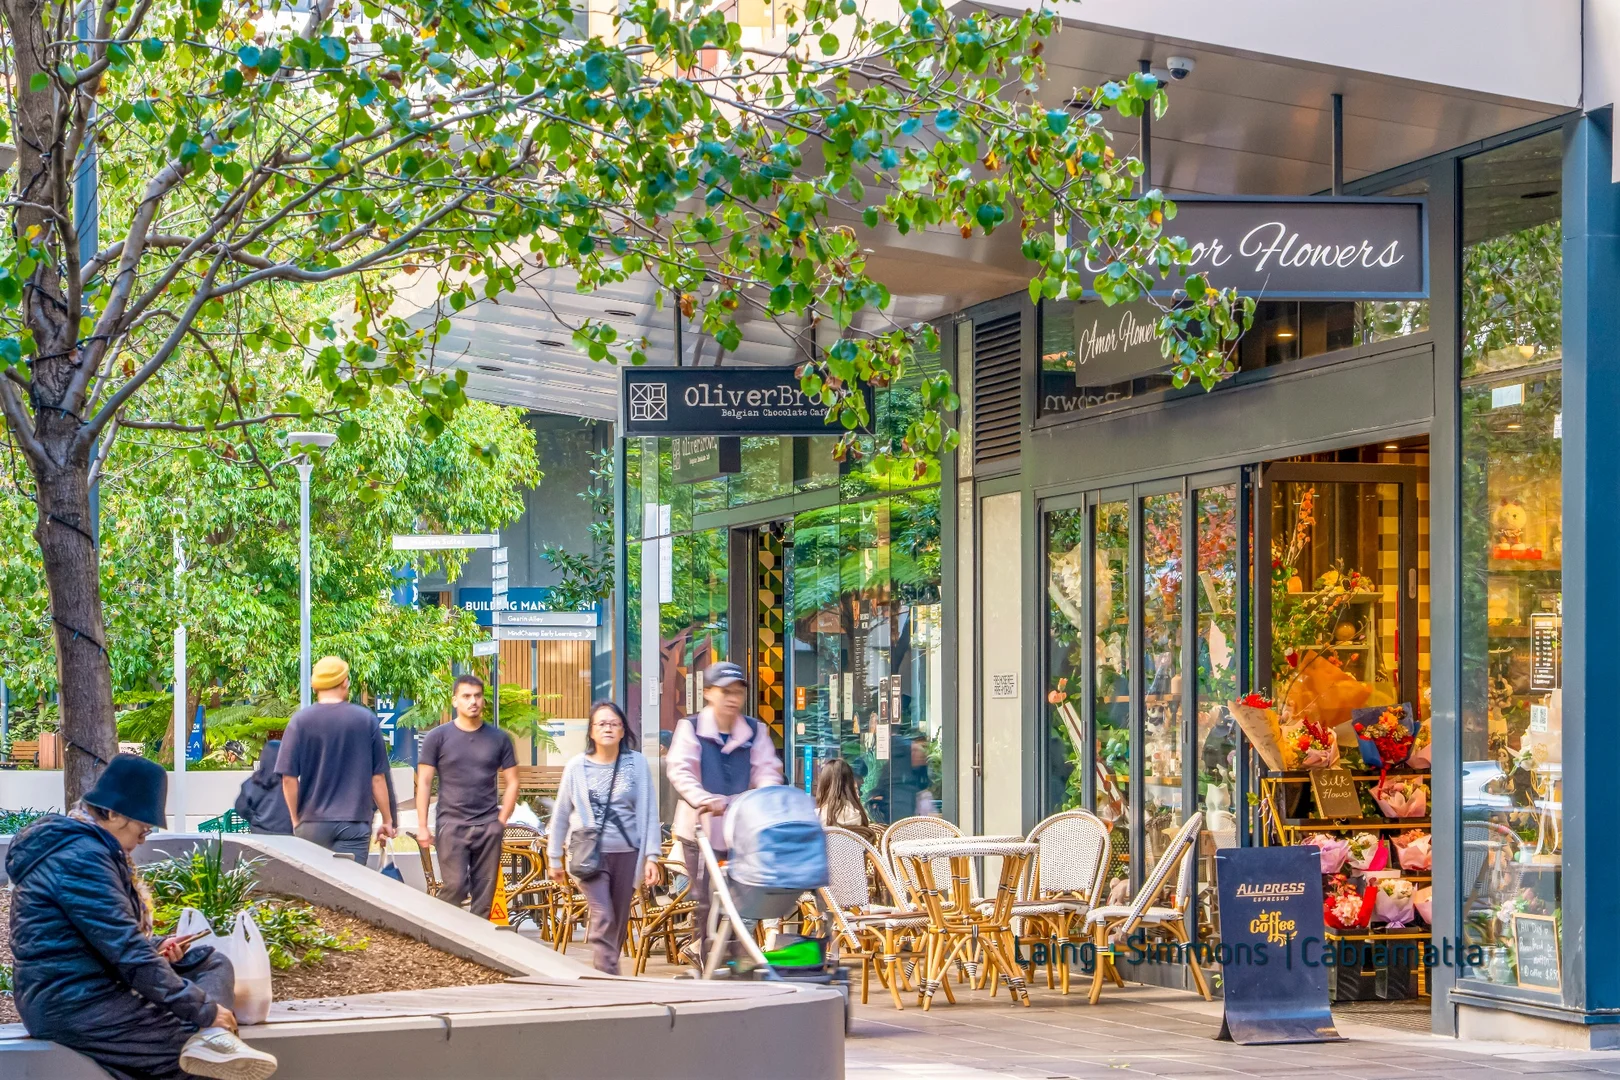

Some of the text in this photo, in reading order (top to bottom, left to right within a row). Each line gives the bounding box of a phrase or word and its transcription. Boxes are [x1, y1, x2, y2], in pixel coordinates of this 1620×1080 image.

[1239, 222, 1404, 272] Flowers
[1080, 319, 1118, 364] Amor
[684, 383, 851, 406] OliverBro
[721, 408, 759, 419] Belgian
[763, 408, 807, 416] Chocolate
[466, 601, 517, 611] BUILG
[529, 615, 544, 623] Alley
[555, 630, 578, 638] Learning
[1250, 910, 1296, 944] Coffee
